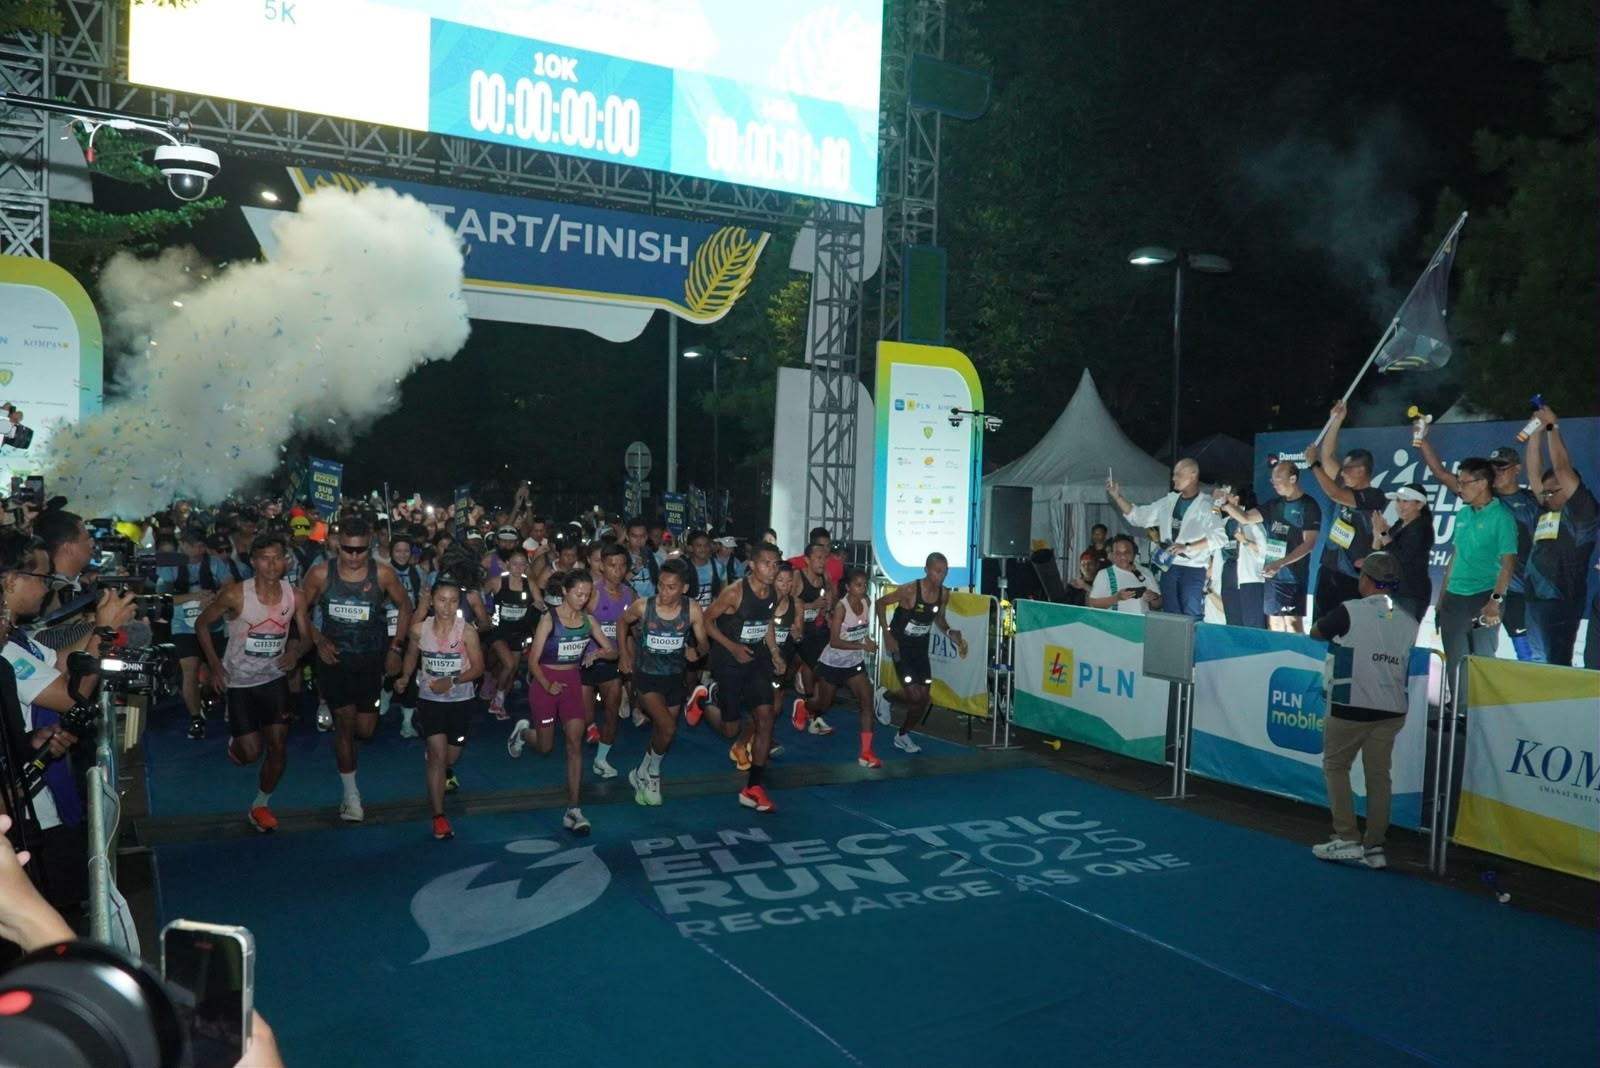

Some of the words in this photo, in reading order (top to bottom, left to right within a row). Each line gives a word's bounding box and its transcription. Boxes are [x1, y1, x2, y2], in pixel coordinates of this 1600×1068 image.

[264, 0, 297, 25] 5K
[533, 52, 578, 83] 10K
[469, 69, 640, 158] 00:00:00:00
[428, 203, 689, 266] TART/FINISH
[318, 485, 333, 495] SUB
[1078, 662, 1135, 699] PLN
[1272, 689, 1303, 709] PLN
[1271, 709, 1325, 732] mobile
[630, 827, 772, 855] PLN
[641, 810, 1102, 882] ELECTRIC
[651, 857, 908, 914] RUN
[921, 828, 1147, 878] 2025
[676, 879, 1003, 938] RECHARGE
[1015, 869, 1080, 892] AS
[1084, 852, 1192, 877] ONE
